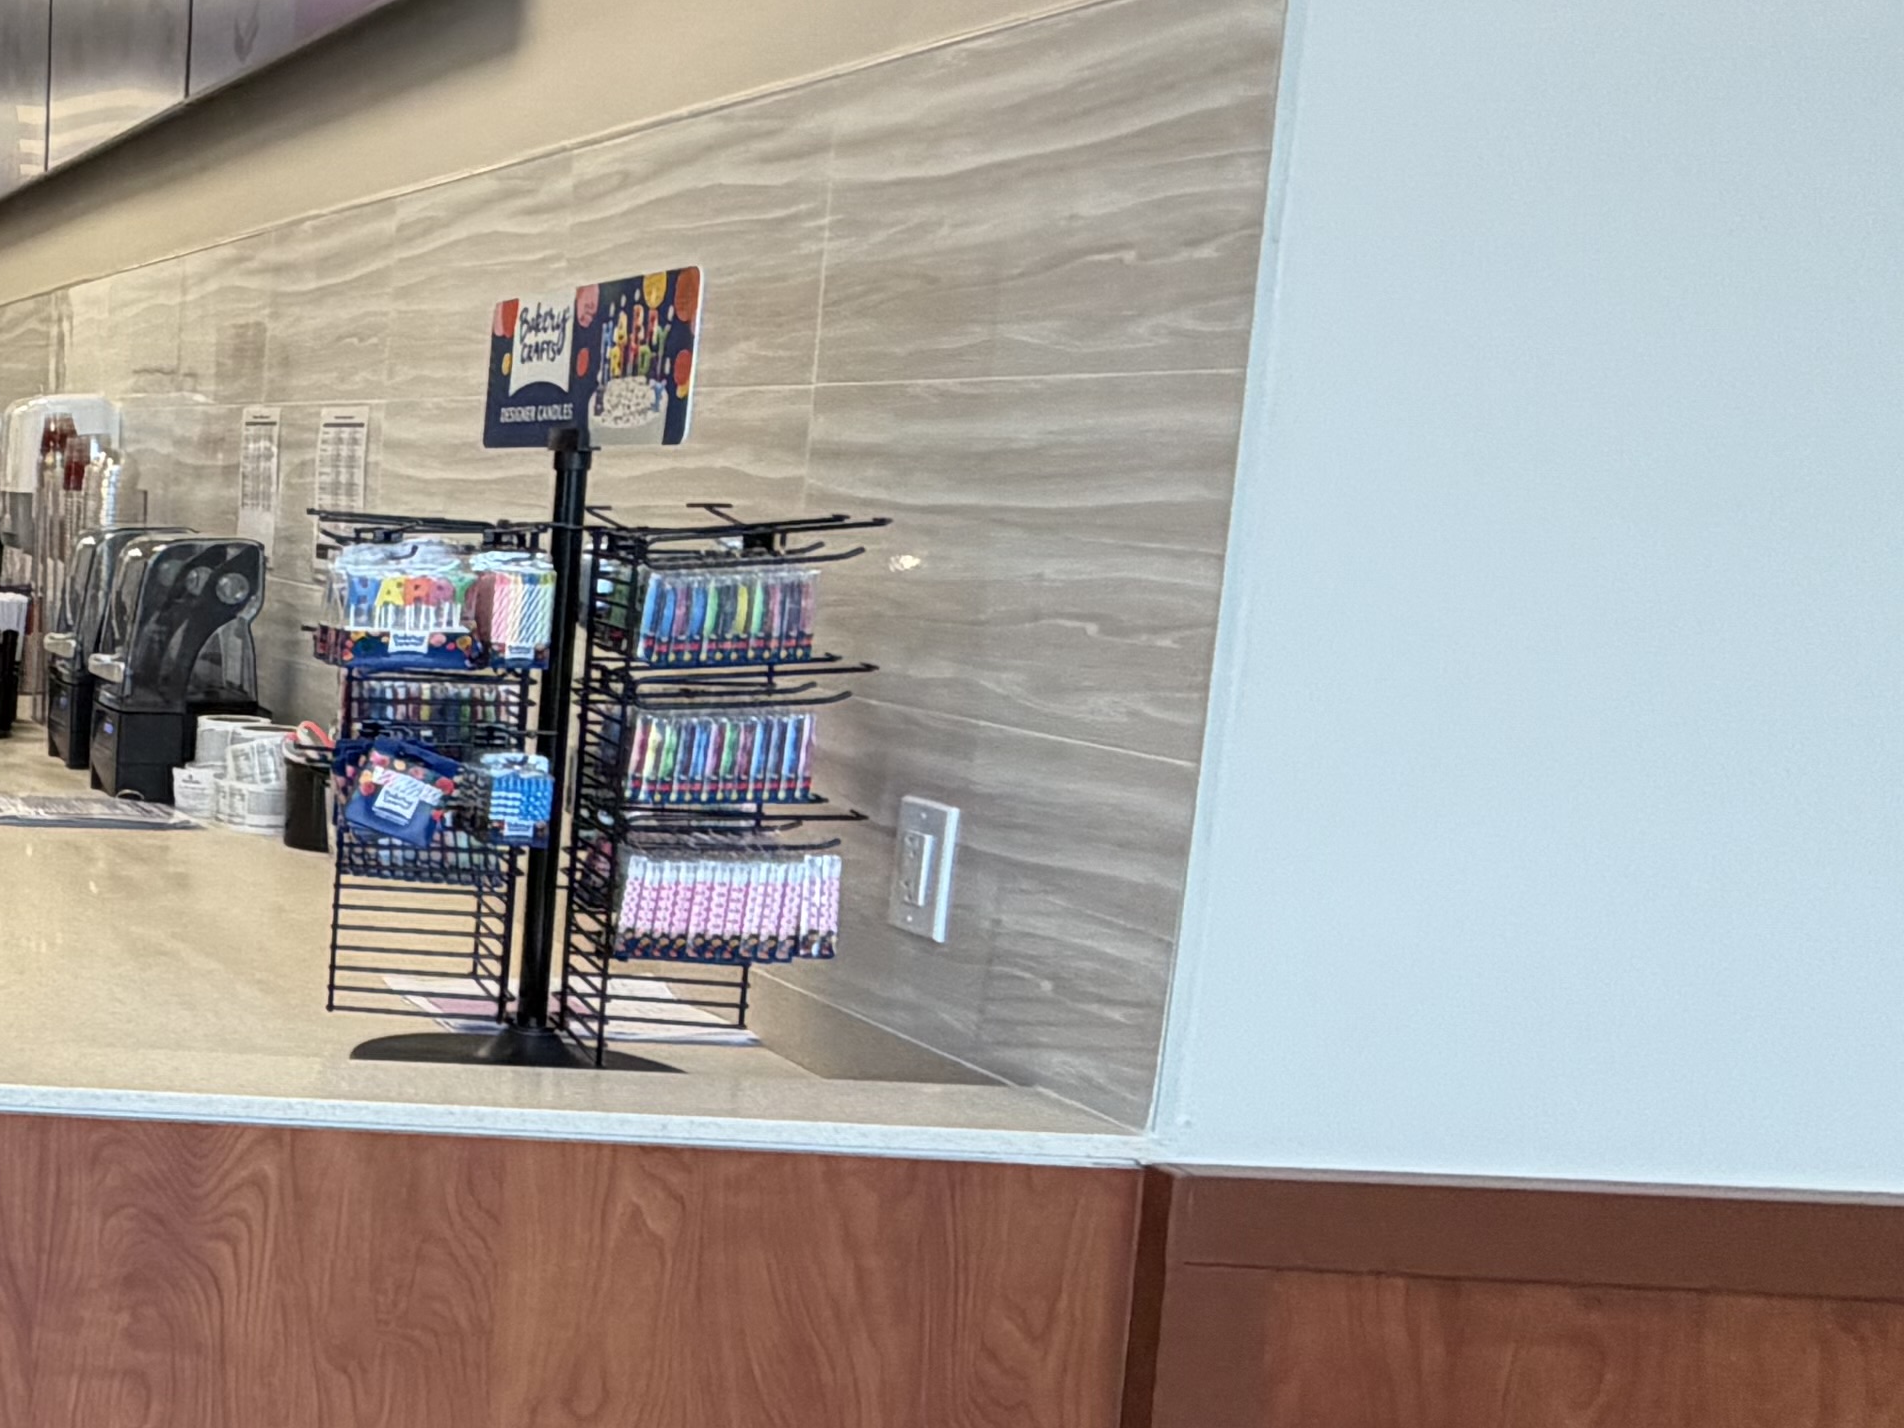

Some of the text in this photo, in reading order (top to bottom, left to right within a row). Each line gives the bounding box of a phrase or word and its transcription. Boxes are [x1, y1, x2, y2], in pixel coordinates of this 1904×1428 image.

[518, 302, 571, 356] Bakery
[520, 340, 558, 365] CRAFTS
[499, 402, 574, 424] DESIGNER CANDLES
